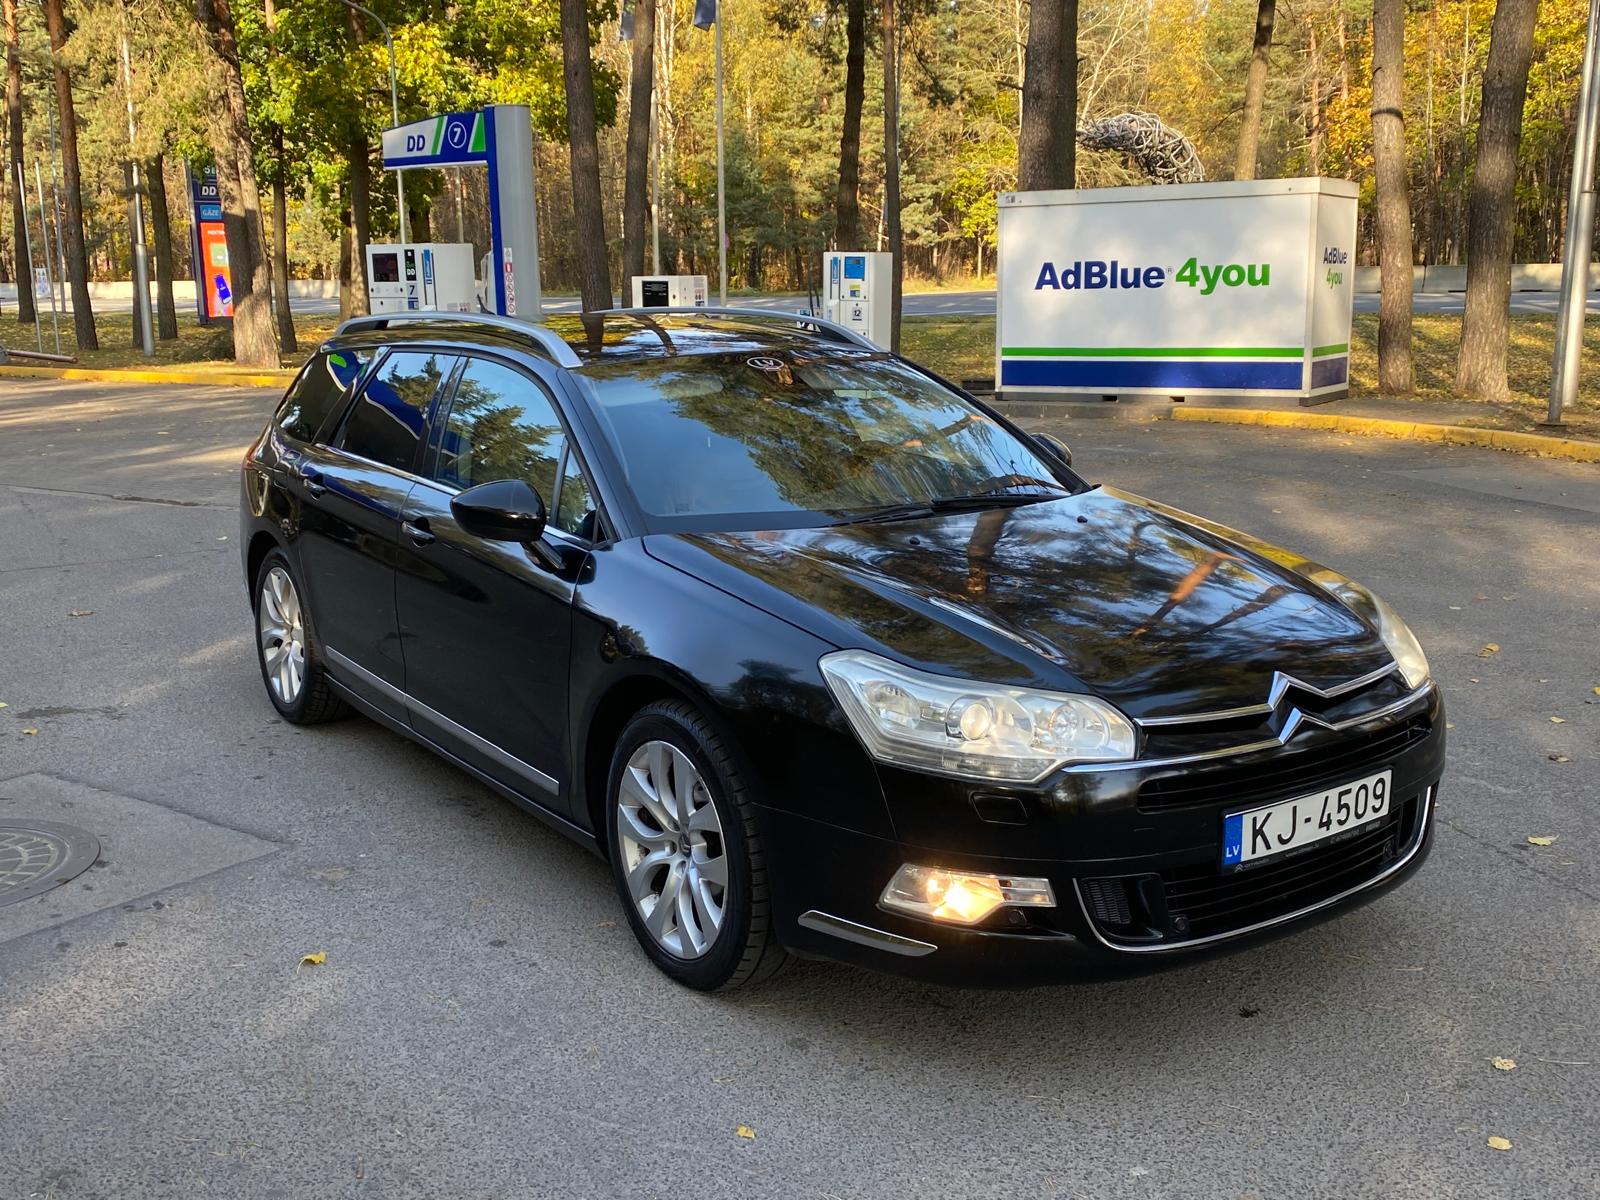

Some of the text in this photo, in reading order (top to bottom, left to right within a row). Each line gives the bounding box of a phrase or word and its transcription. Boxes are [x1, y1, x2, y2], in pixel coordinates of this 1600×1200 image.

[407, 134, 426, 152] DD
[453, 127, 462, 143] 7
[202, 186, 216, 196] DD
[1323, 247, 1347, 264] AdBlue
[1175, 257, 1270, 295] 4you
[1326, 267, 1343, 289] 4you
[409, 285, 415, 295] 7
[853, 309, 862, 317] 12
[1250, 777, 1386, 855] KJ-4509
[1226, 845, 1240, 858] LV
